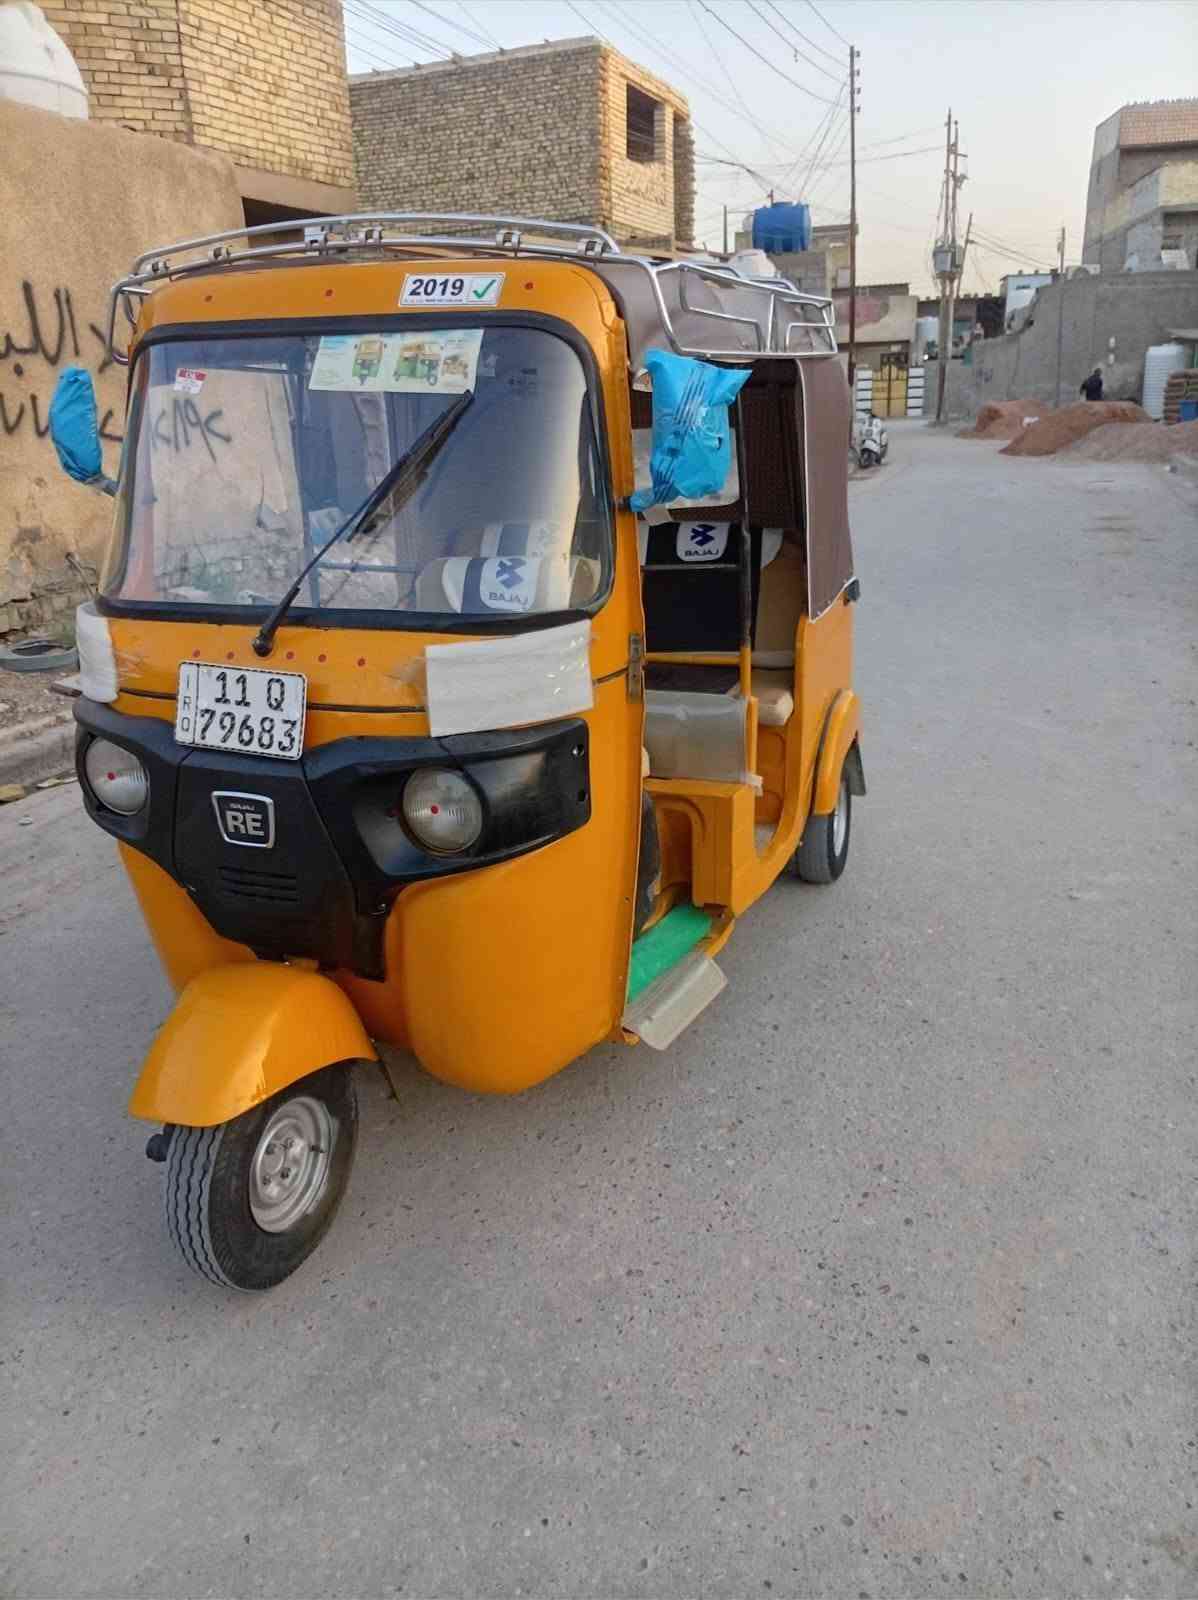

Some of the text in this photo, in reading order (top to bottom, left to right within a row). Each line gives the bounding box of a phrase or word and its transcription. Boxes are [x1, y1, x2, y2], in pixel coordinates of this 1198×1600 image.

[408, 278, 465, 296] 2019
[684, 548, 719, 557] BAJAJ
[214, 671, 286, 712] 11 Q
[199, 708, 297, 752] 79683
[225, 810, 265, 836] RE
